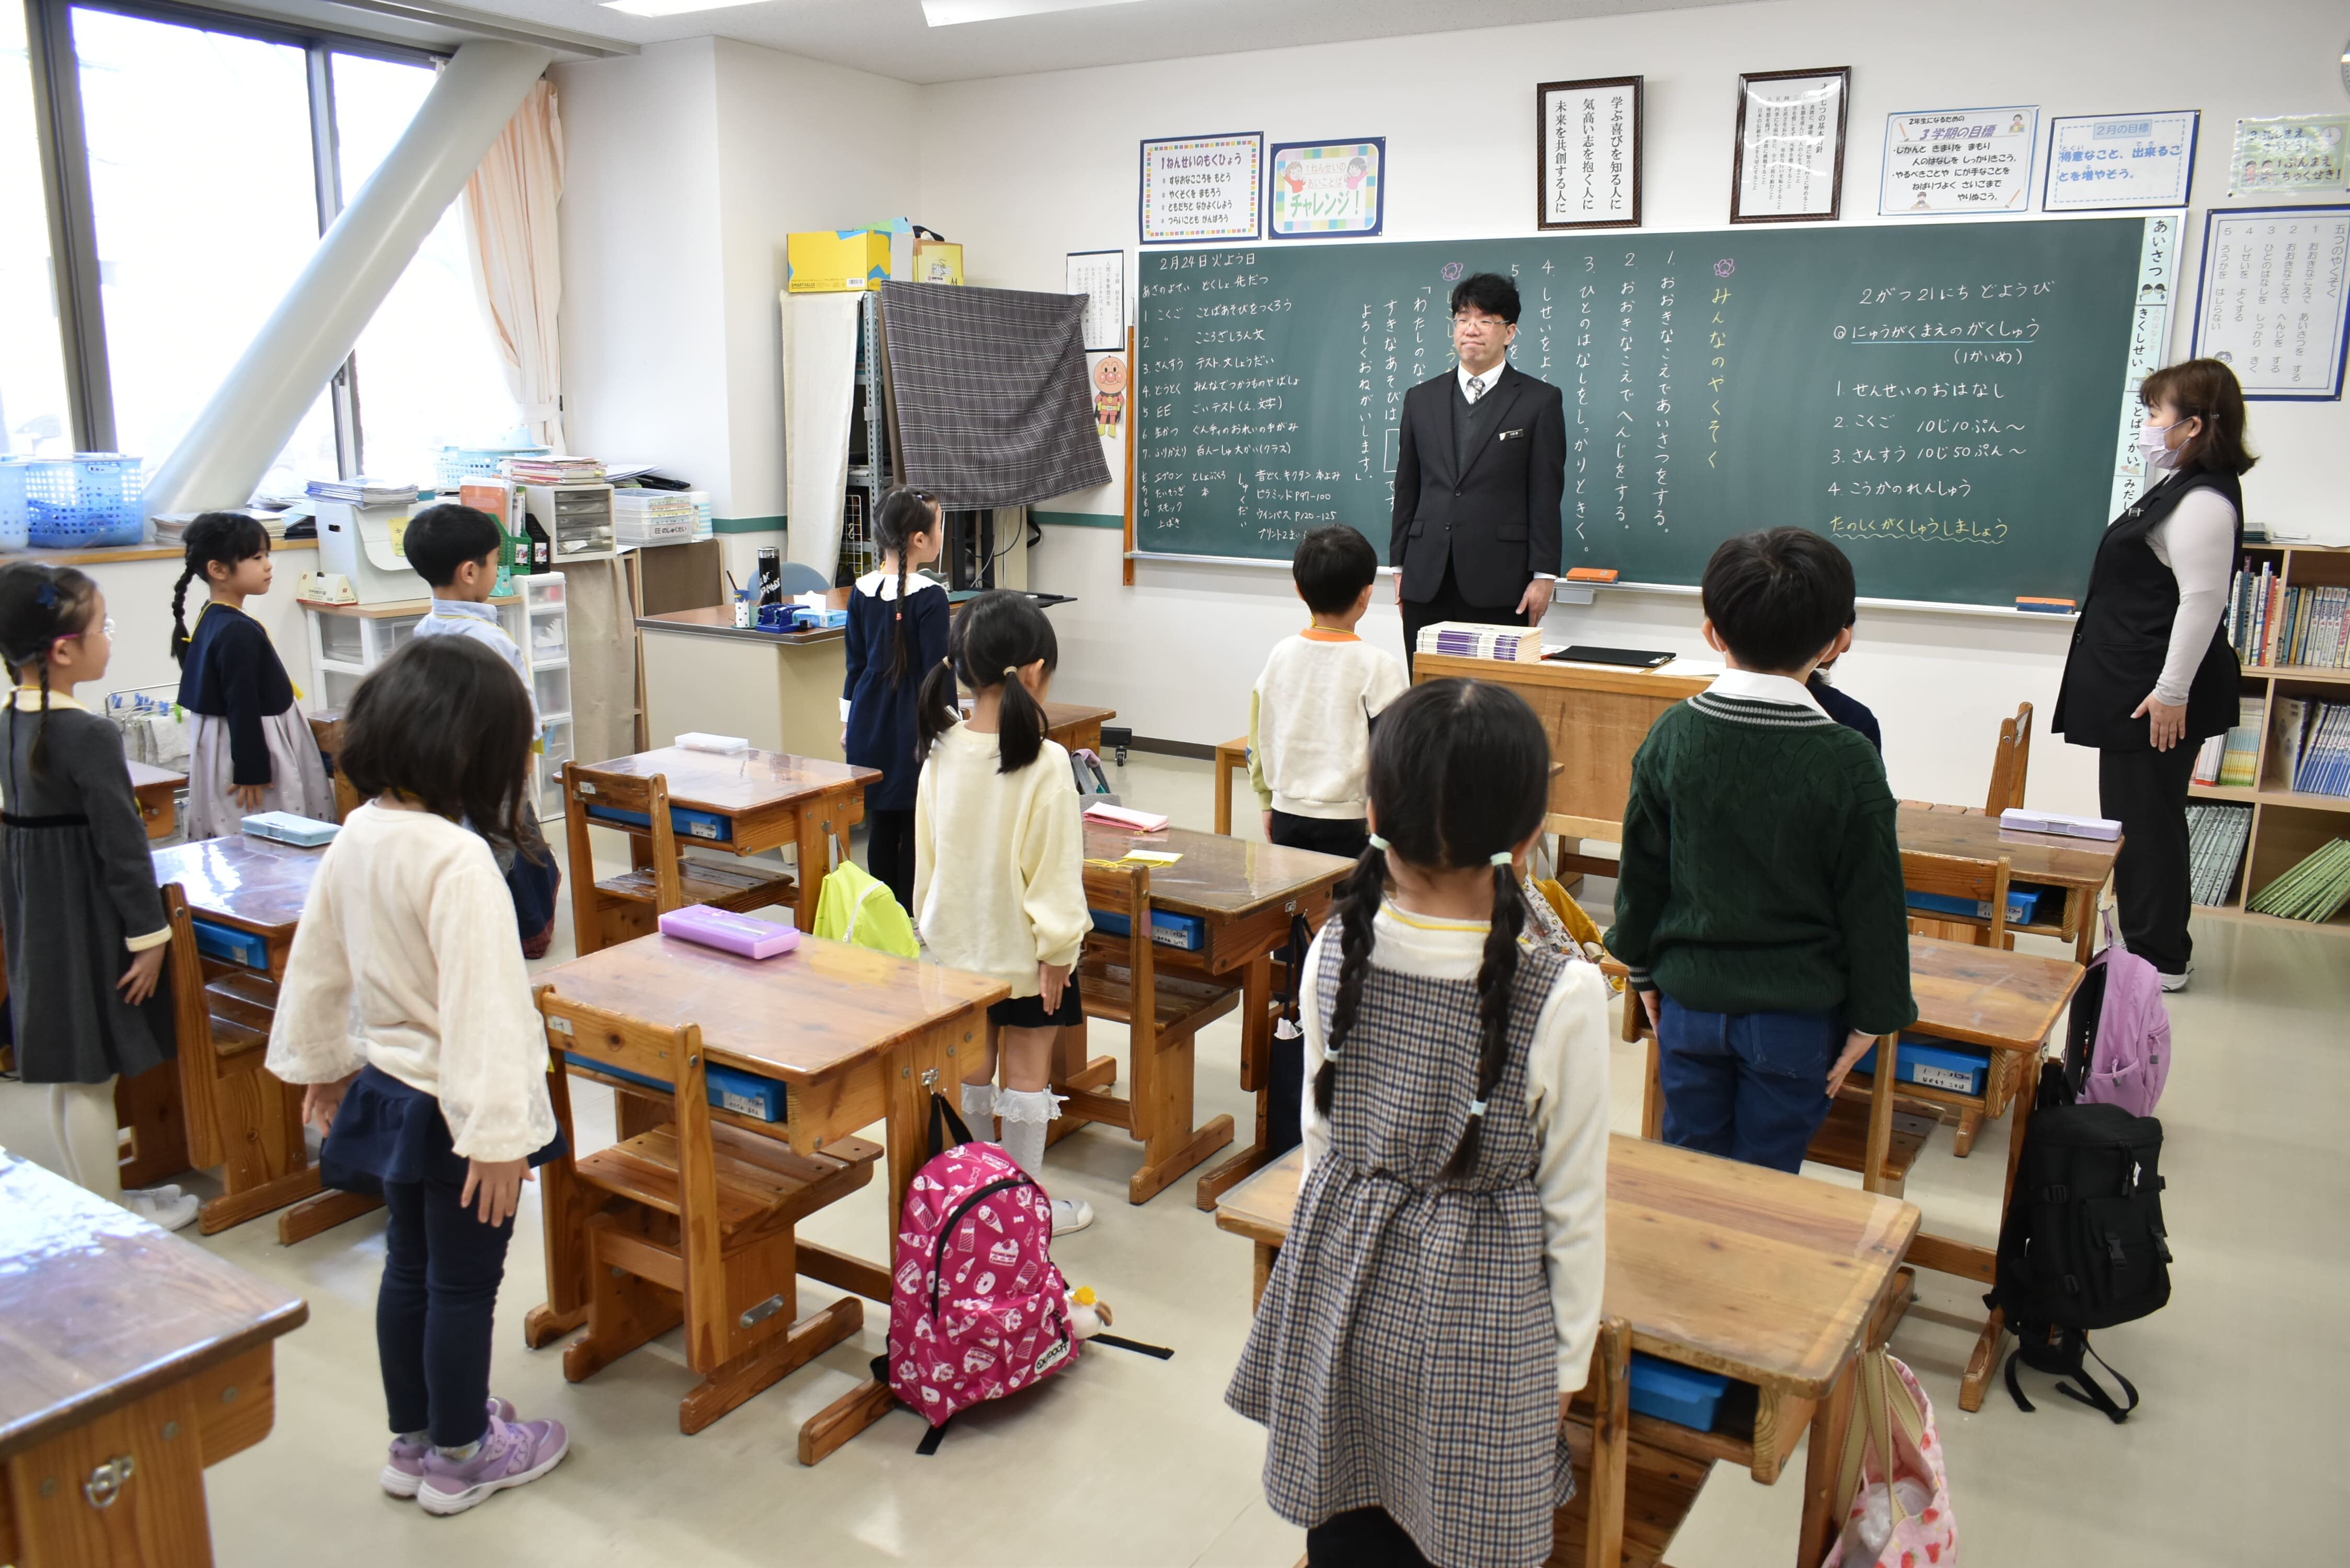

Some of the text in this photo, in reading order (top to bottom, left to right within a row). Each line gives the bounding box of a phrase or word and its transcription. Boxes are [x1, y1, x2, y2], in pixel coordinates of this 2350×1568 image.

[1908, 116, 1965, 125] 2年生になるための
[2096, 123, 2150, 135] 2月の目標
[1919, 124, 1998, 141] 3学期の目標
[1582, 98, 1595, 210] 気高い志を抱く人に
[1610, 96, 1623, 210] 学ぶ喜びを知る人に
[1932, 144, 1961, 153] きまりを
[1968, 142, 1990, 151] まもり
[1161, 153, 1241, 170] 1ねんせいのもくひょう
[1555, 100, 1567, 213] 未来を共創する人に
[1912, 154, 2017, 166] 人のはなしを しっかりきこう。
[1306, 163, 1346, 172] 1ねんせいの
[1955, 167, 2010, 176] にが手なことを
[2059, 169, 2134, 181] とを増やそう。
[1169, 172, 1231, 185] すなおなこころを もとう
[1308, 177, 1342, 188] あいことば
[1913, 180, 2002, 191] ねばりづよく さいごまで
[1169, 188, 1221, 199] やくそくを まもろう
[1168, 200, 1232, 212] ともだちと なかよくしよう
[1168, 214, 1228, 225] つらいことも がんばろう
[2149, 220, 2167, 276] あいさつ
[2219, 245, 2230, 279] ろうかを
[2240, 245, 2252, 279] しせいを
[2327, 225, 2346, 298] 五つのやくそく
[2258, 244, 2274, 304] ひとのはなしを
[2280, 243, 2296, 304] おおきなこえで
[2302, 243, 2318, 304] おおきなこえで
[1143, 283, 1190, 298] あさのよてい
[1859, 280, 2056, 305] 2がつ21にち どようび
[1158, 307, 1184, 320] こくご
[1196, 298, 1292, 318] ことばあそびをつくろう
[2211, 288, 2225, 330] はしらない
[2234, 289, 2246, 322] よくする
[1196, 328, 1265, 344] こころざしろん文
[1413, 286, 1432, 385] 「わたしのな
[1852, 318, 2040, 340] にゅうがくまえのがくしゅう
[2133, 308, 2148, 367] きくしせい
[2253, 314, 2265, 347] しっかり
[2275, 314, 2286, 347] へんじを
[2296, 313, 2309, 356] あいさつを
[1383, 299, 1400, 421] すきなあそびは
[1954, 348, 2022, 364] (1かいめ)
[2250, 356, 2259, 373] きく
[2271, 356, 2281, 373] する
[1155, 358, 1183, 373] さんすう
[2291, 365, 2302, 382] する
[1708, 287, 1732, 468] みんなのやくそく
[1155, 383, 1181, 395] どうとく
[1852, 382, 2005, 398] せんせいのおはなし
[1157, 403, 1171, 418] EE
[1615, 281, 1634, 529] おおきなこえでへんじをする。
[1653, 276, 1676, 534] おおきなこえであいさつをする。
[1574, 284, 1595, 552] ひとのはなしをしっかりときく。
[1833, 417, 1849, 428] 2.
[1855, 414, 1896, 429] こくご
[1155, 426, 1179, 439] 生かつ
[1155, 445, 1186, 457] ふりかえり
[1831, 448, 1845, 464] 3.
[1852, 446, 1907, 464] さんすう
[1154, 470, 1226, 483] エプロン としょぶくろ
[1142, 471, 1150, 517] もちもの
[1155, 485, 1209, 498] たいそうぎ 本
[1257, 489, 1293, 501] ピラミッド
[1828, 478, 1972, 498] 4. こうかのれんしゅう
[1157, 502, 1182, 513] スモック
[1238, 473, 1249, 528] しゅくだい
[1157, 516, 1180, 529] 上ばき
[1257, 508, 1291, 521] ウインパス
[1830, 515, 2008, 538] たのしくがくしゅうしましょう
